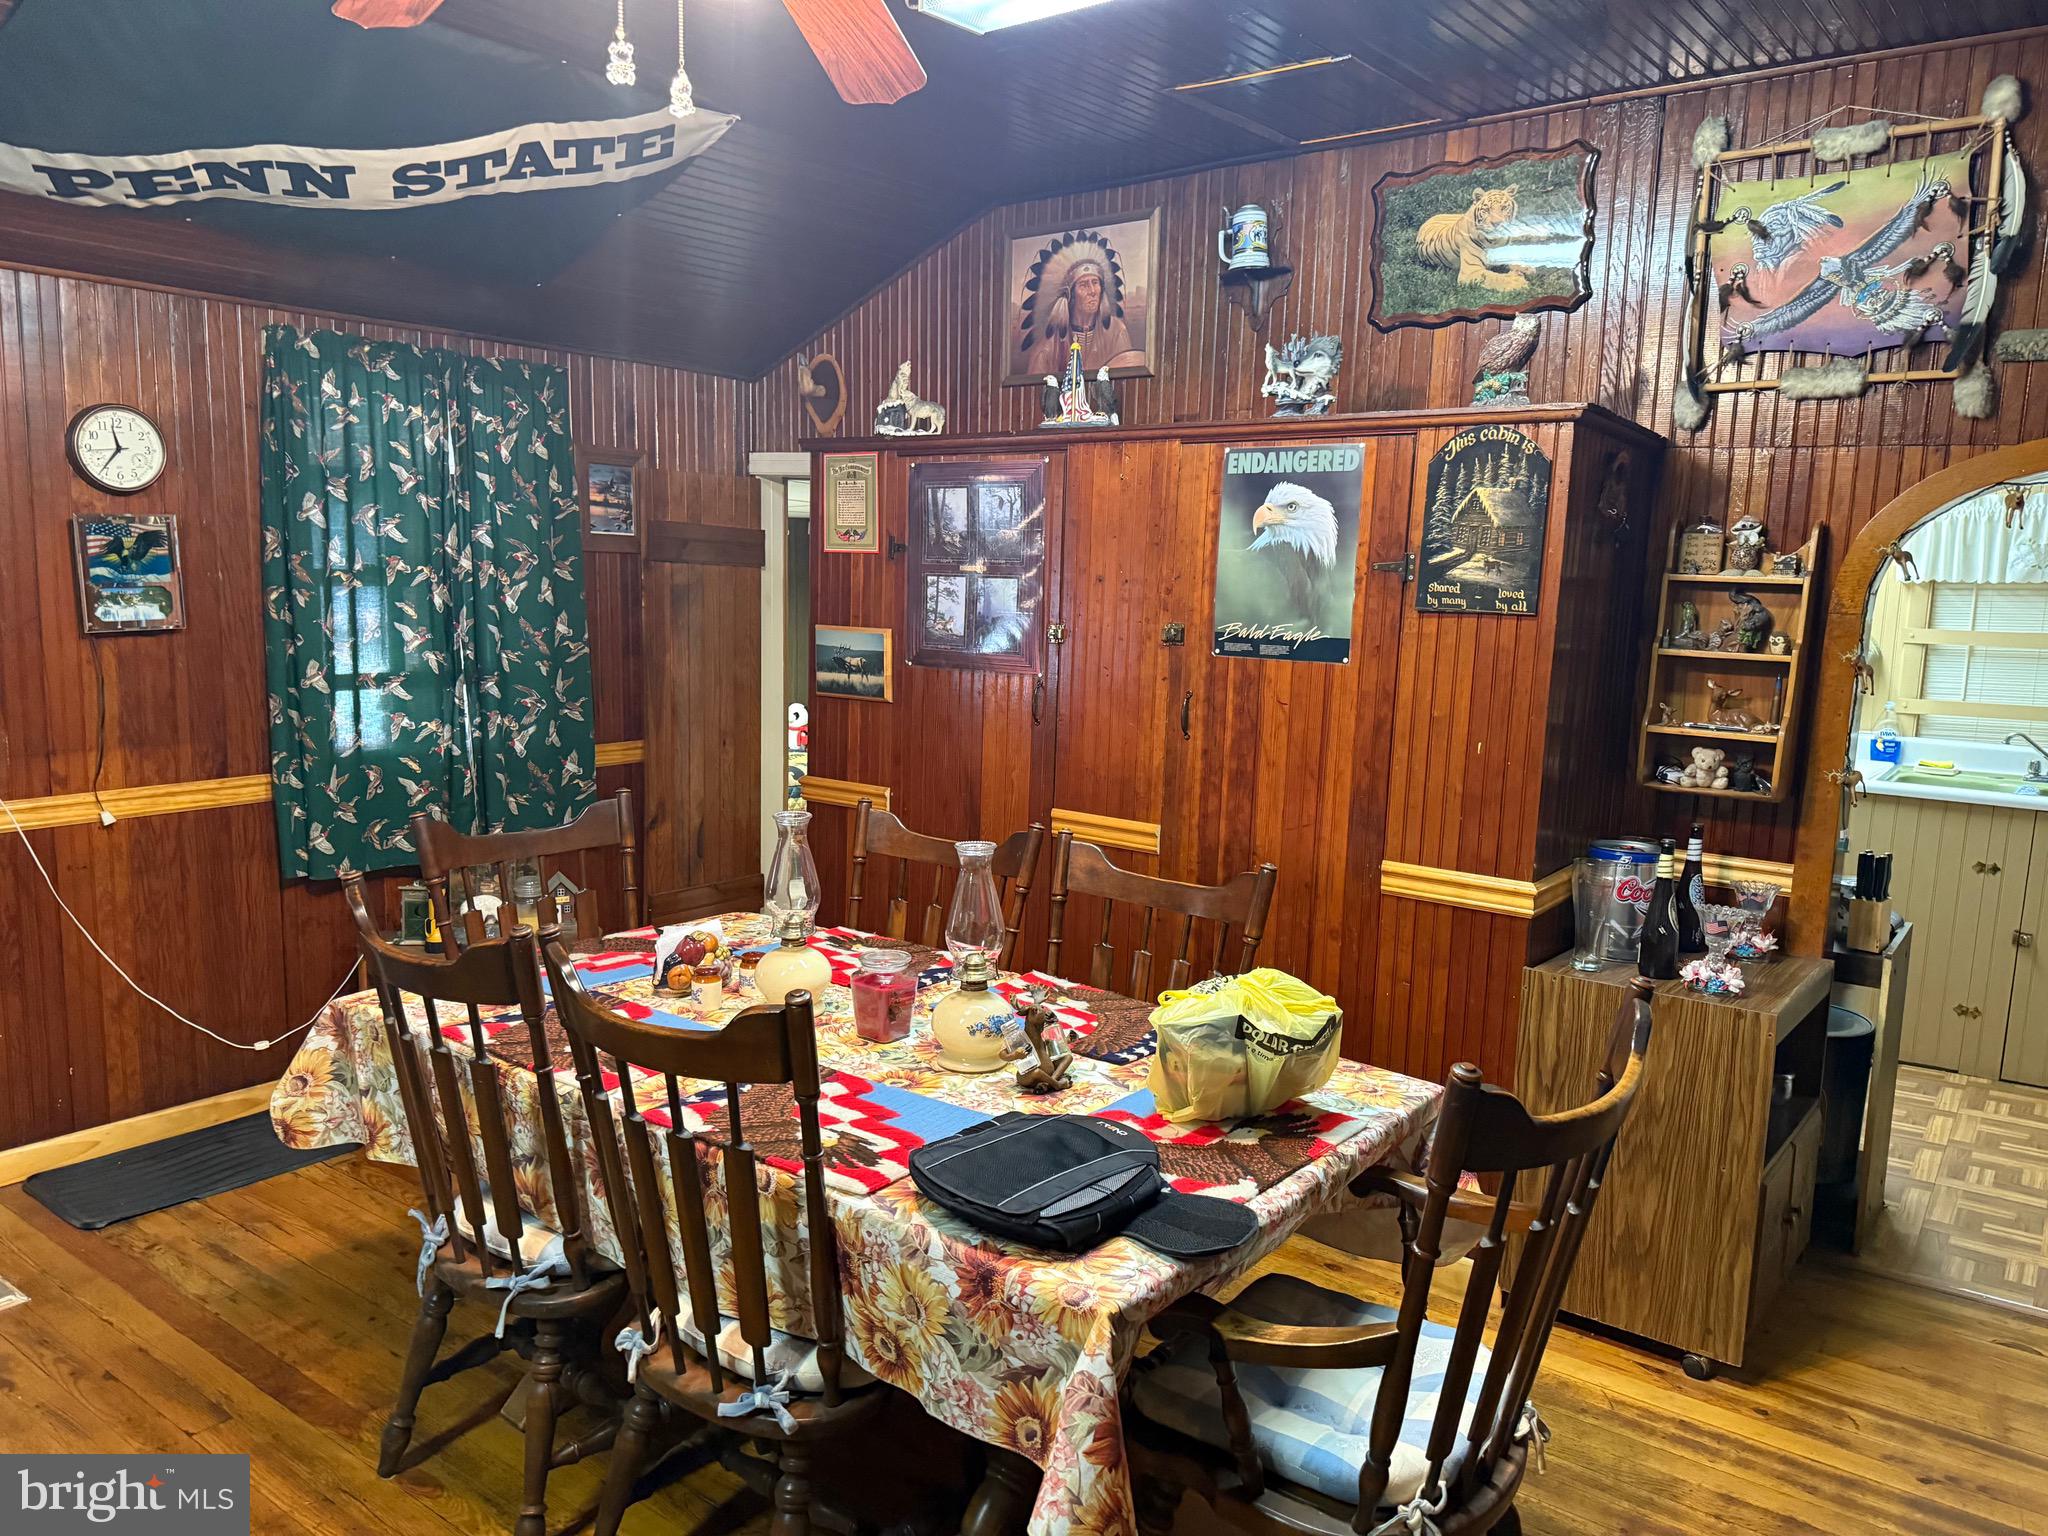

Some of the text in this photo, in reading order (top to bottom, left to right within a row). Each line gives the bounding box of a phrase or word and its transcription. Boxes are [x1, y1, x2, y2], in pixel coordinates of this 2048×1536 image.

[32, 123, 676, 199] PENN STATE
[97, 421, 107, 431] 11
[128, 422, 133, 431] 1
[88, 430, 98, 440] 10
[137, 432, 145, 441] 2
[84, 443, 92, 452] 9
[1444, 426, 1536, 461] This cabin is
[144, 446, 151, 455] 3
[1227, 449, 1360, 474] ENDANGERED
[116, 471, 124, 480] 6
[130, 469, 138, 478] 5
[1428, 582, 1460, 594] shared
[1498, 588, 1525, 600] loved
[1427, 594, 1467, 610] by many
[1495, 600, 1528, 613] by all
[1217, 622, 1271, 641] Bald
[1269, 623, 1330, 650] Eagle
[1615, 879, 1655, 902] Coo
